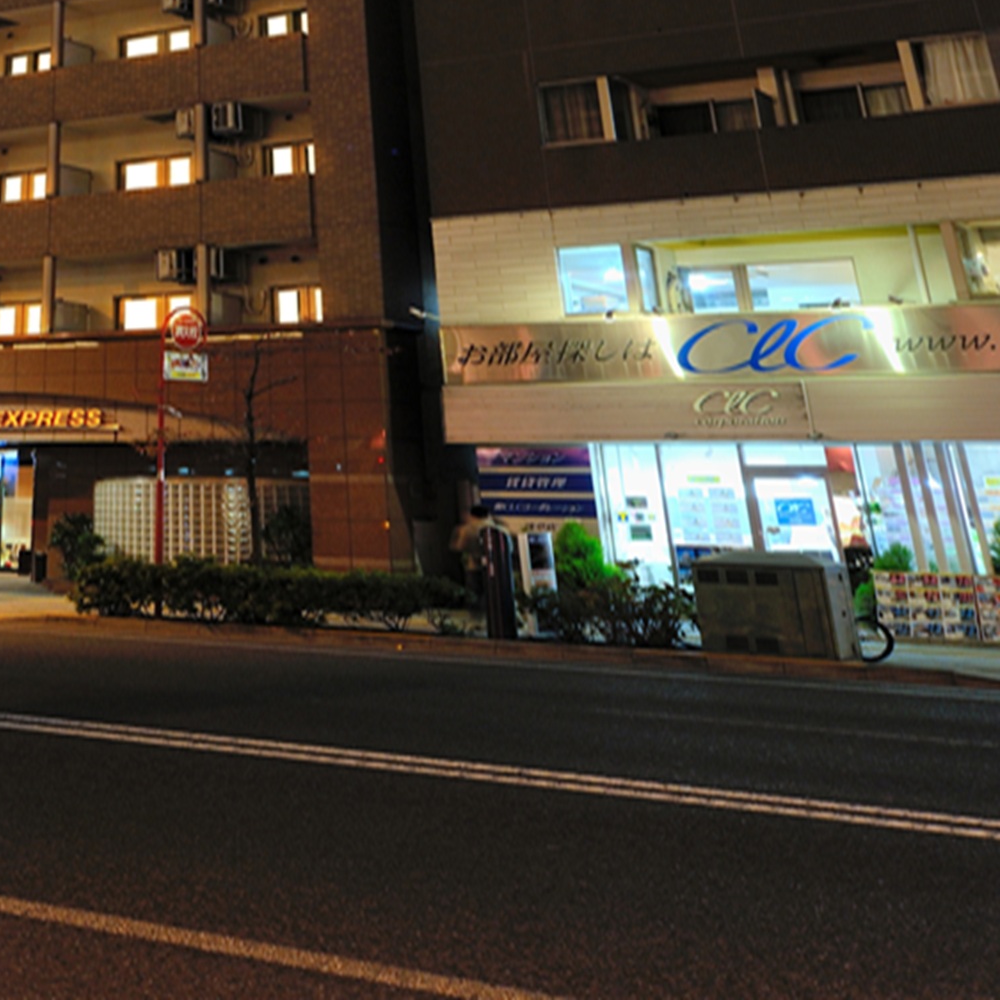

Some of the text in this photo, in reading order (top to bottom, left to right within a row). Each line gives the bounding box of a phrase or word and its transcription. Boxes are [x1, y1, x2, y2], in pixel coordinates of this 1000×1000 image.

[458, 338, 655, 367] お部屋探しは
[894, 332, 998, 353] www.
